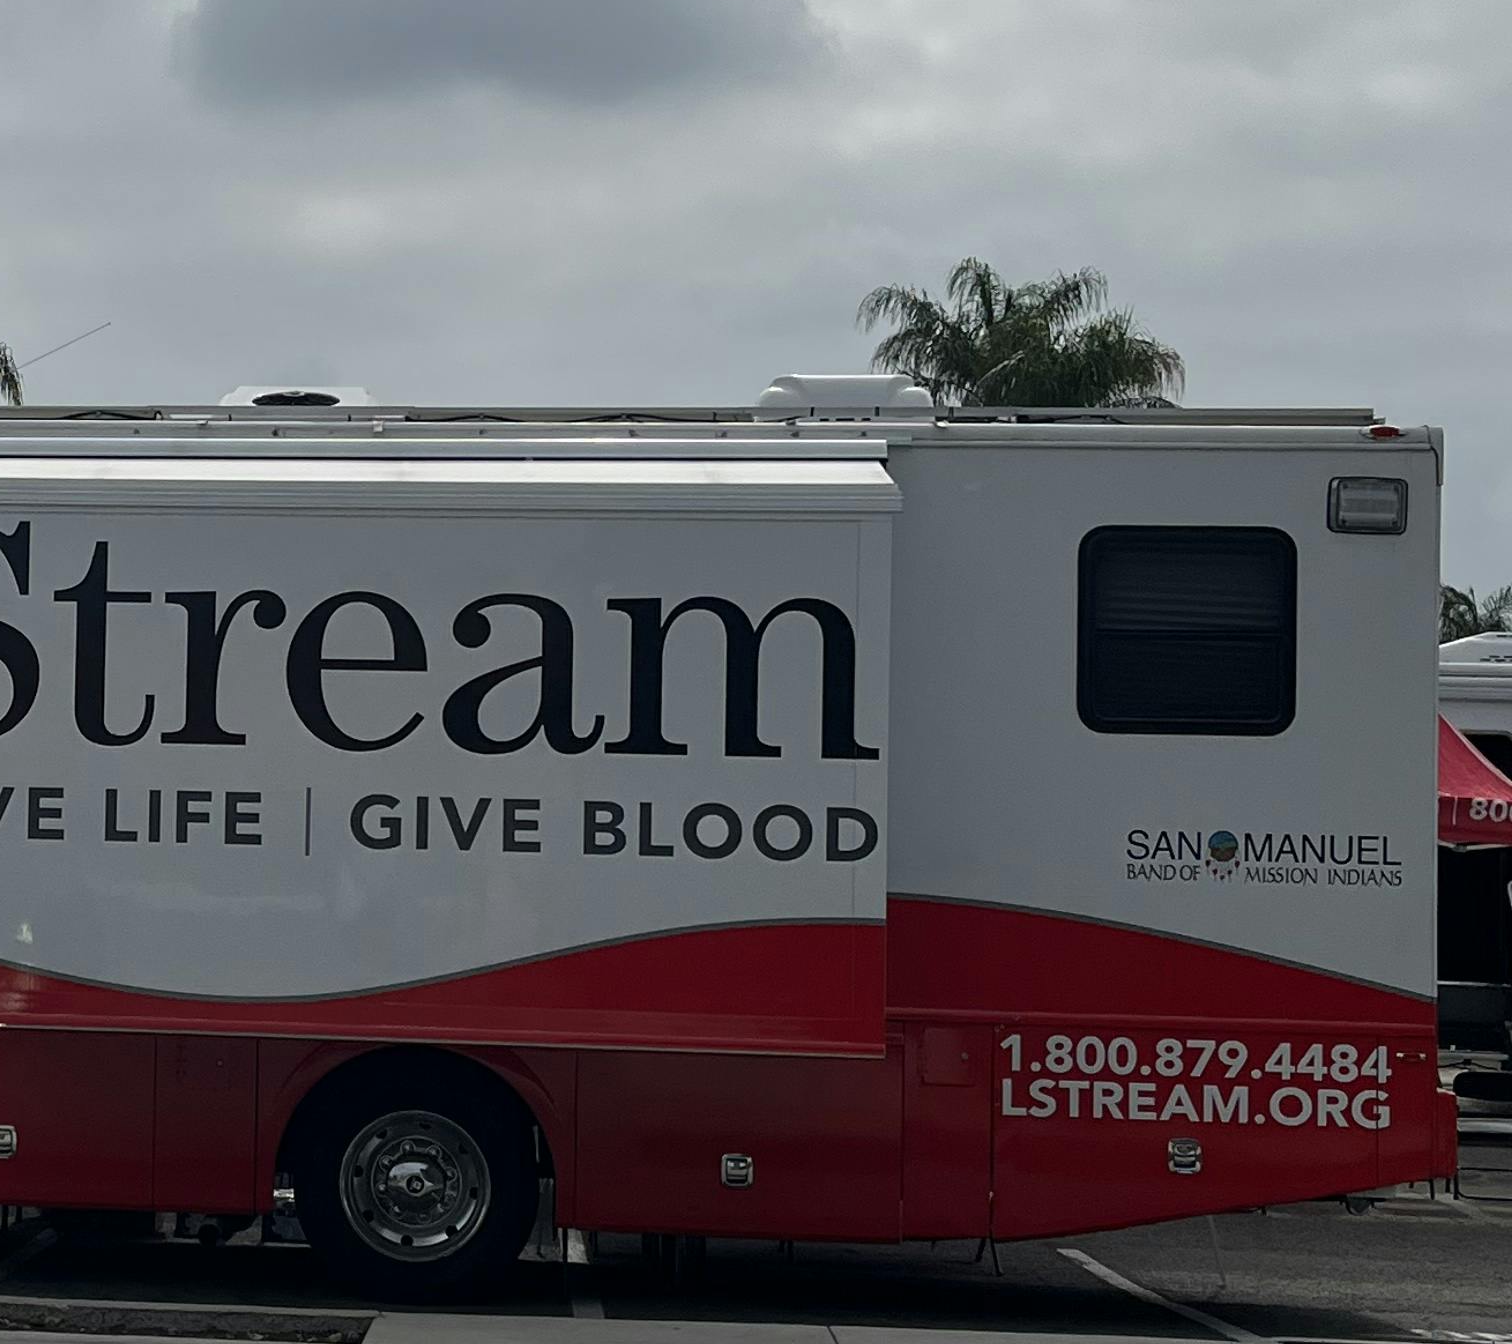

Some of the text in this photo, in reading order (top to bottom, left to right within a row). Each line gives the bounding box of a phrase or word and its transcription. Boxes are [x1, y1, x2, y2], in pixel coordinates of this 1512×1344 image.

[105, 787, 262, 845] LIFE
[350, 794, 541, 853] GIVE
[584, 801, 879, 862] BLOOD
[1469, 797, 1512, 823] 80
[1127, 830, 1402, 865] SAN MANUEL
[1127, 863, 1402, 887] BAND OF MISSION INDIANS
[1000, 1034, 1392, 1084] 1.800.879.4484
[1001, 1078, 1391, 1129] LSTREAM.ORG
